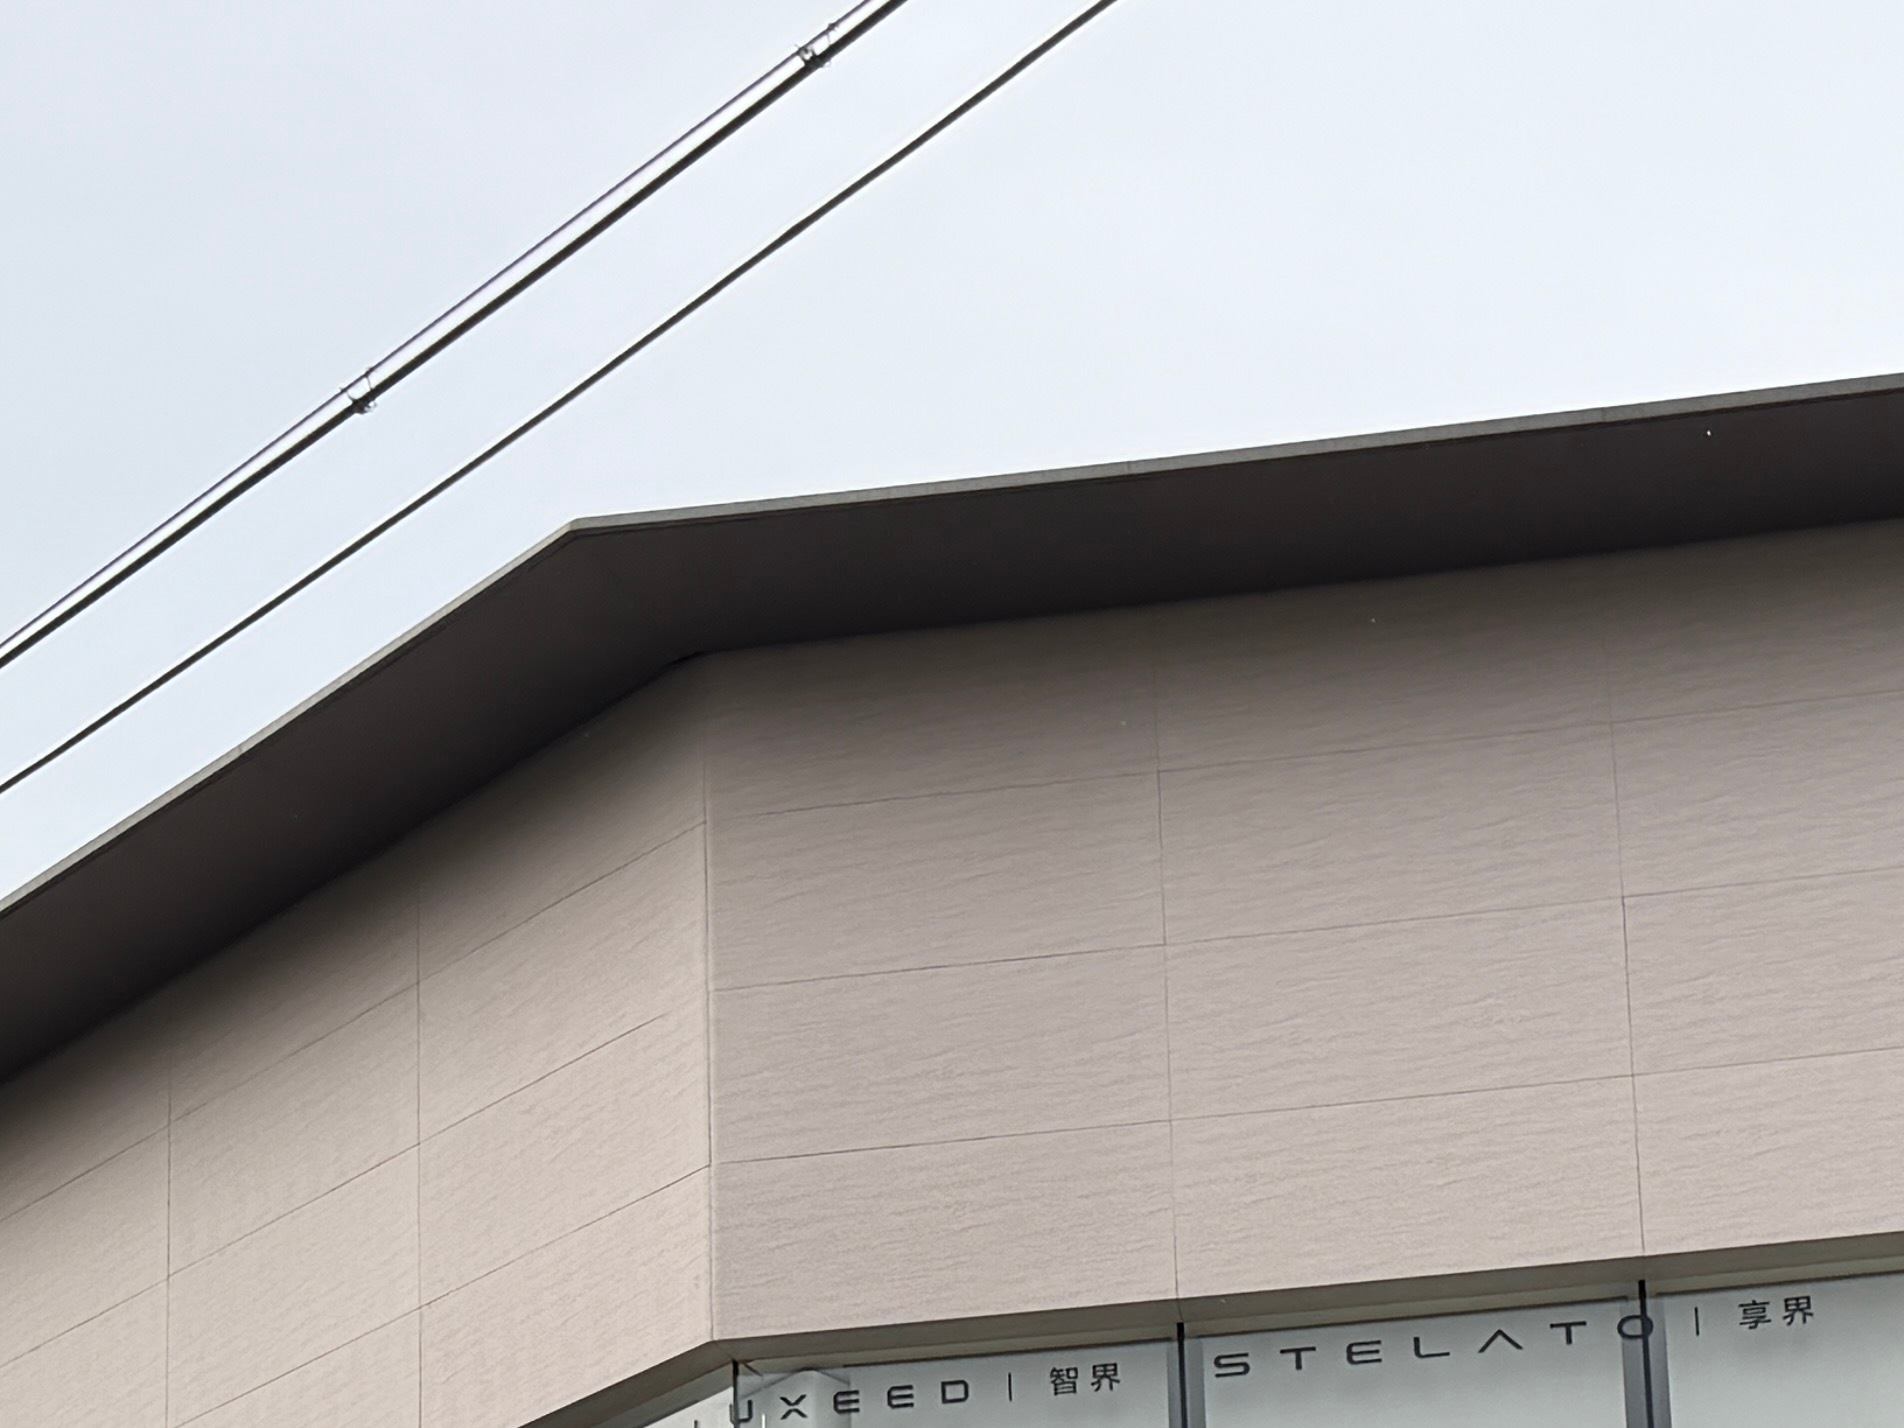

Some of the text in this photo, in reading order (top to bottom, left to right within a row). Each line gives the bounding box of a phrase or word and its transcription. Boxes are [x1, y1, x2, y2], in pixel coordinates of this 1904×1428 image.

[1738, 1295, 1814, 1332] 享界
[1213, 1314, 1654, 1378] STELATO
[1048, 1361, 1121, 1398] 智界
